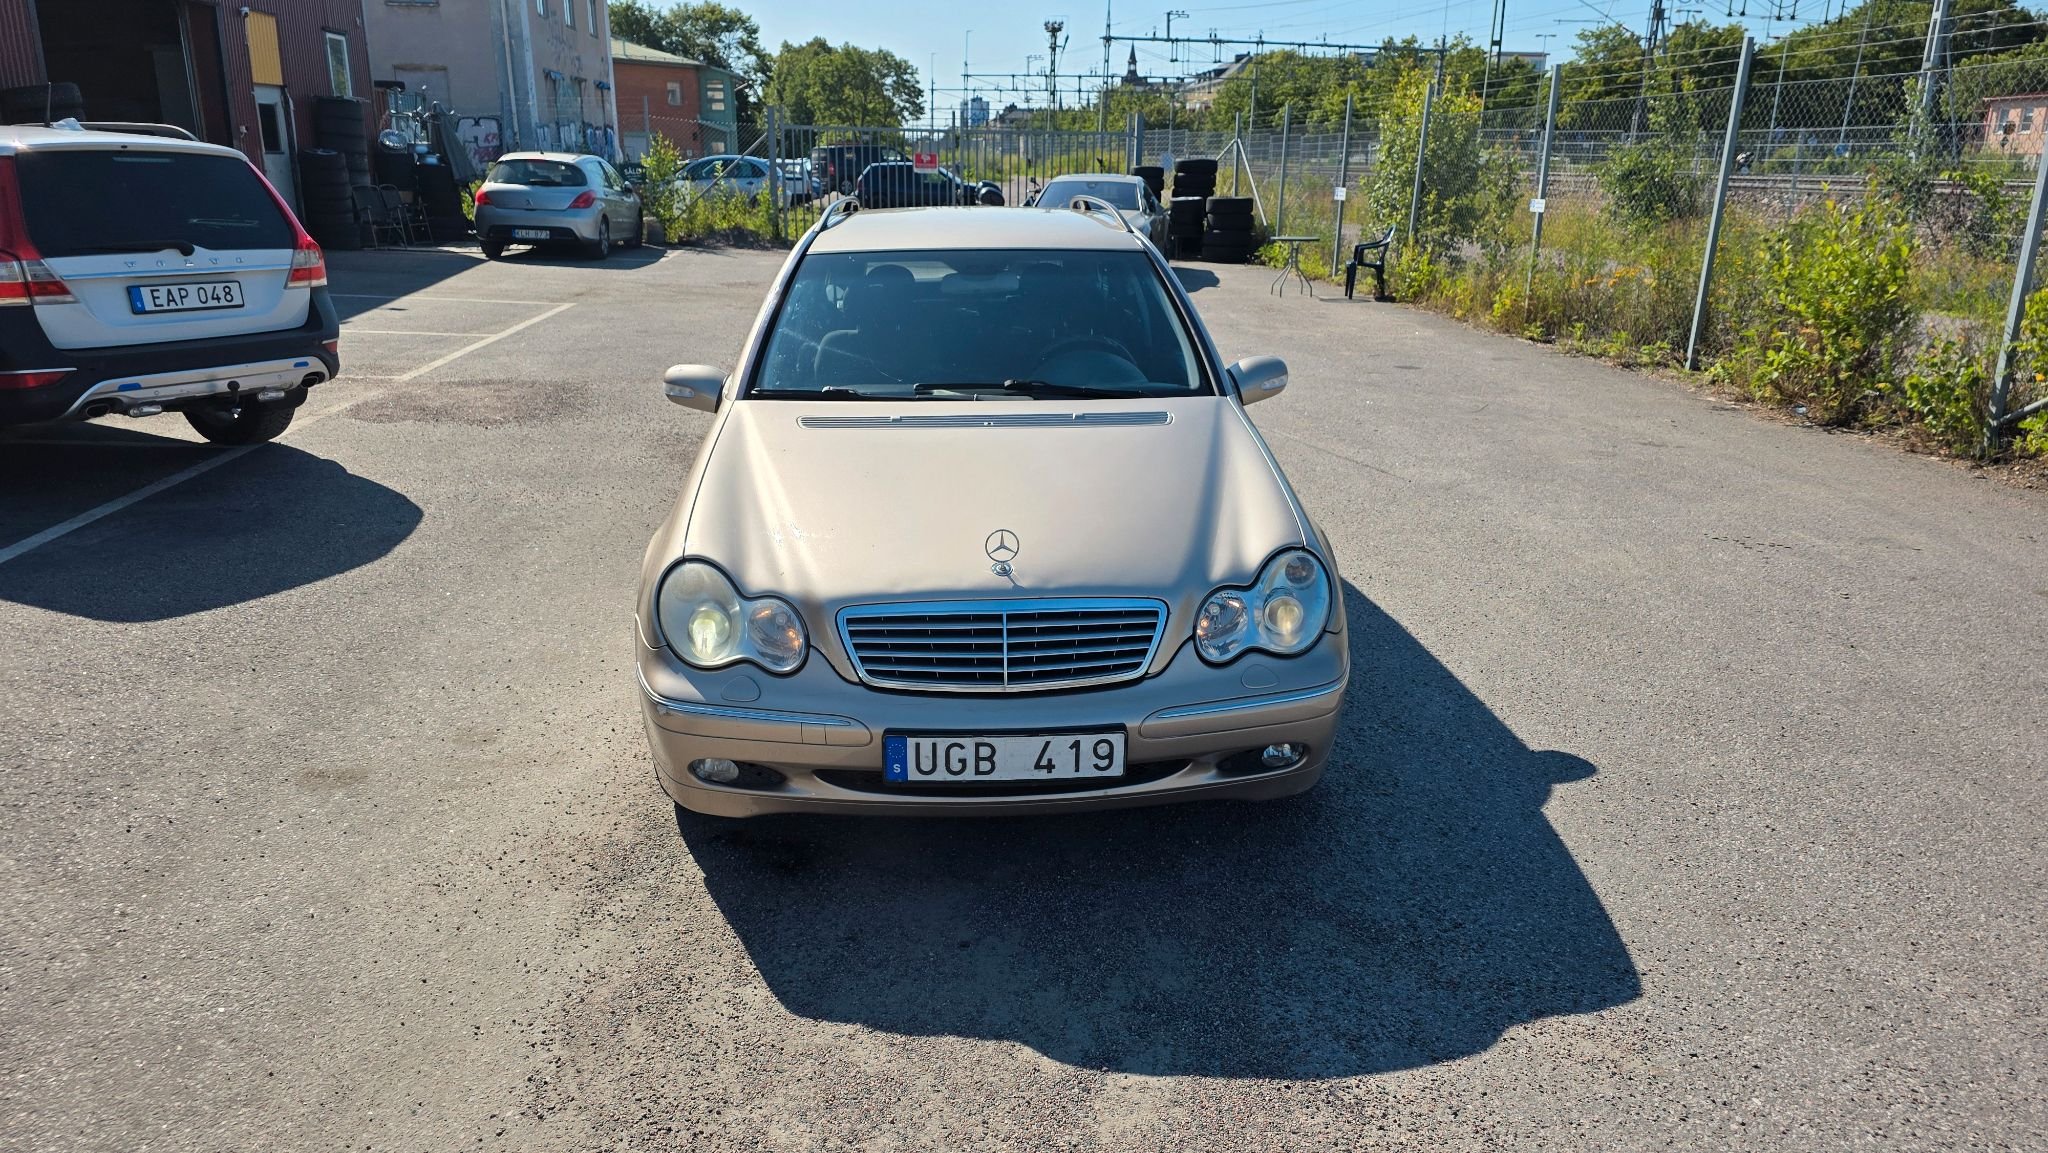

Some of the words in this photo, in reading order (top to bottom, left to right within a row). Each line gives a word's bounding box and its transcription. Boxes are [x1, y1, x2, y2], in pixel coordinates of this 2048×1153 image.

[124, 257, 244, 268] VOLVO
[150, 287, 189, 308] EAP
[197, 285, 234, 305] 048
[915, 741, 997, 776] UGB
[1033, 738, 1115, 774] 419
[893, 763, 901, 774] S
